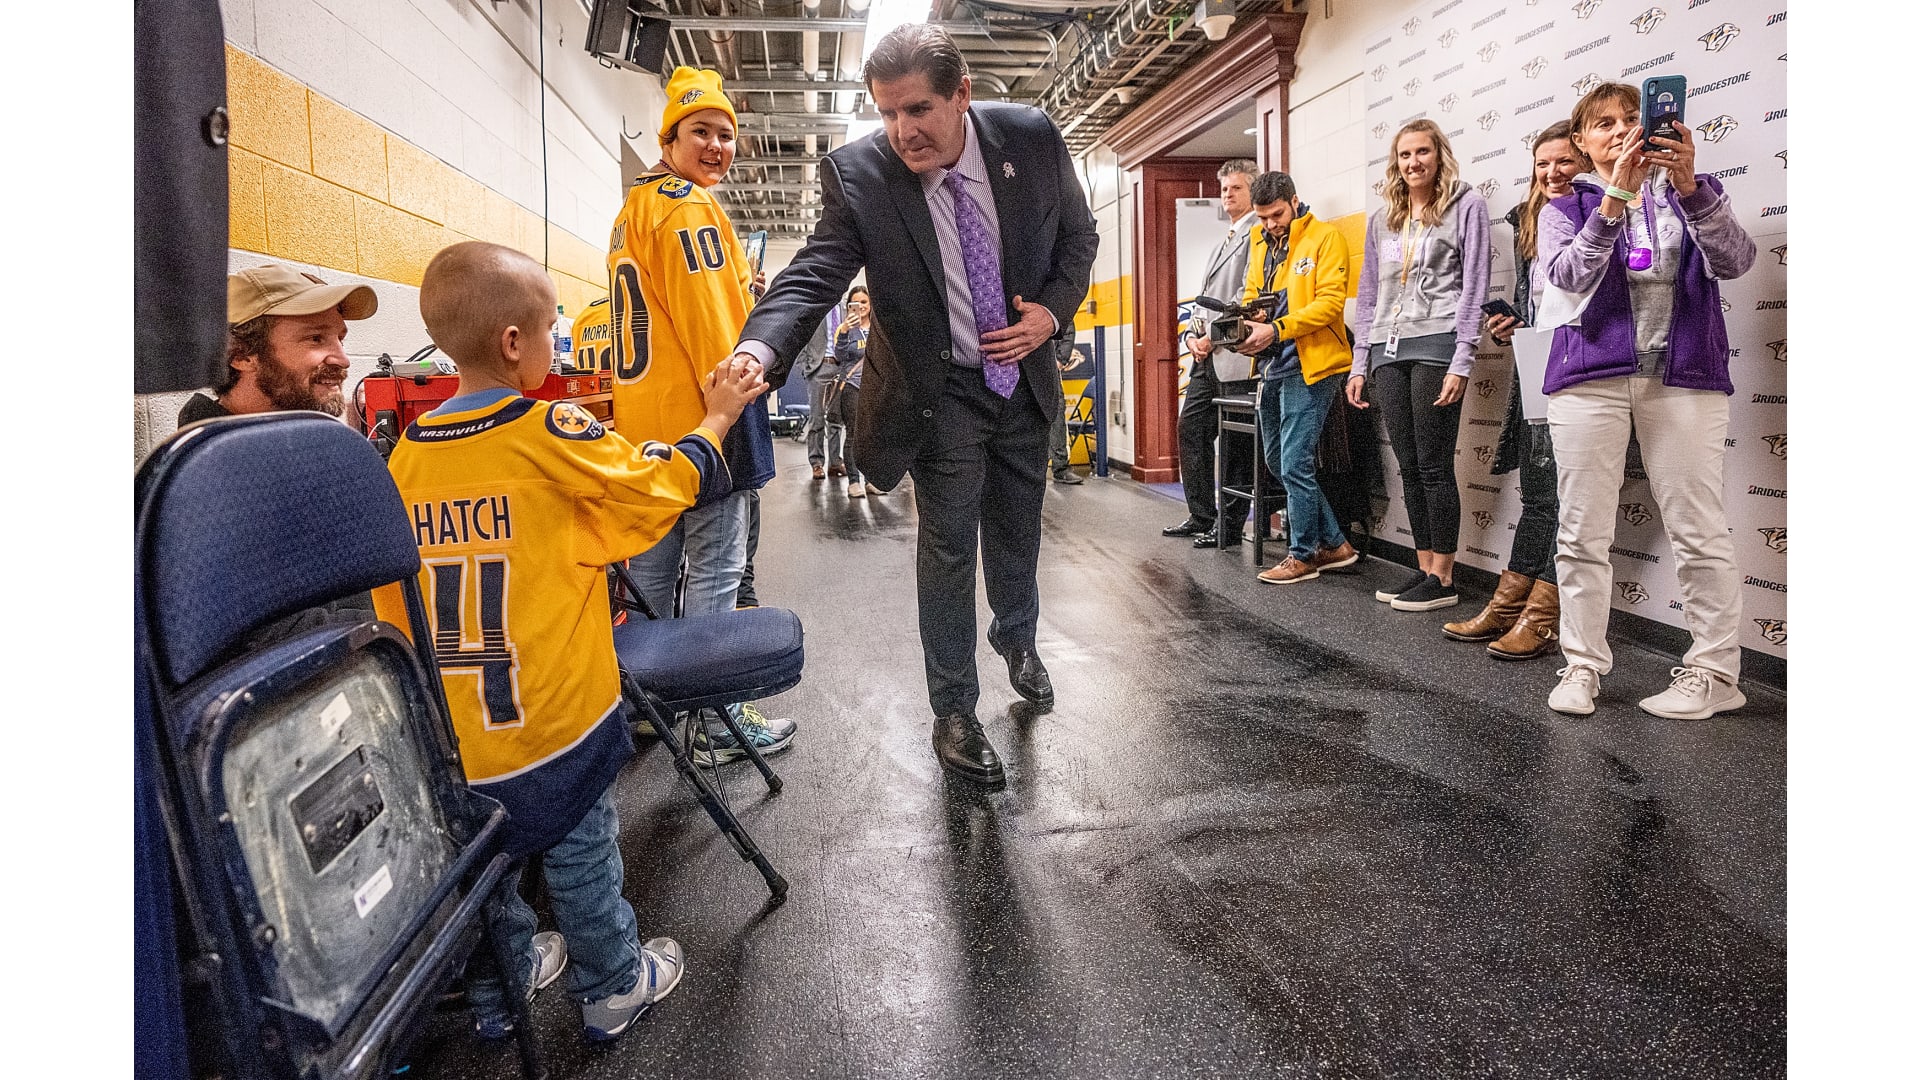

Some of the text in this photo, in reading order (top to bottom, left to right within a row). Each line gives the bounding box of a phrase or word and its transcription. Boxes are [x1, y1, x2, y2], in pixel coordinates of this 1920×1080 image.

[1515, 20, 1555, 45] BRIDGESTONE
[1564, 35, 1611, 60] BRIDGESTONE
[1621, 52, 1676, 78] BRIDGESTONE
[1687, 71, 1752, 99] BRIDGESTONE
[1515, 95, 1555, 116] BRIDGESTONE
[674, 225, 725, 274] 10
[419, 420, 496, 437] NASHVILLE
[413, 495, 513, 547] HATCH
[421, 554, 524, 732] 4
